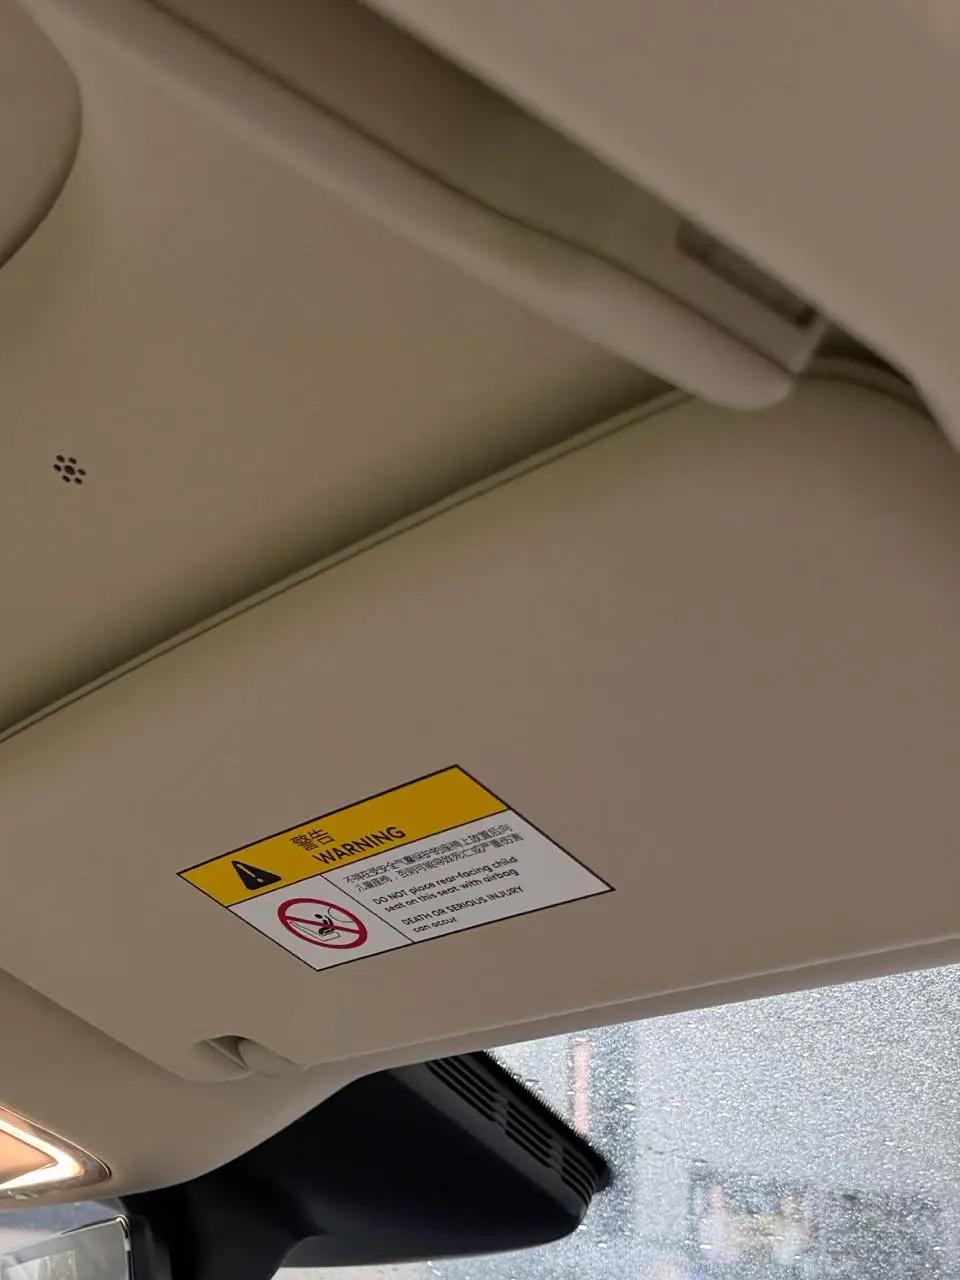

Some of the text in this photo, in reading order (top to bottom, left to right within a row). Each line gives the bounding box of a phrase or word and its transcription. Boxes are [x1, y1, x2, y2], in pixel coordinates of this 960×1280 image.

[289, 828, 336, 852] 警告
[311, 826, 407, 865] WARNING
[371, 855, 519, 905] DO NOT place rear-facing child
[383, 868, 520, 913] seat on this seat with airbag
[400, 885, 524, 926] DEATH OR SERIOUS INJURY
[412, 916, 457, 933] can occur
